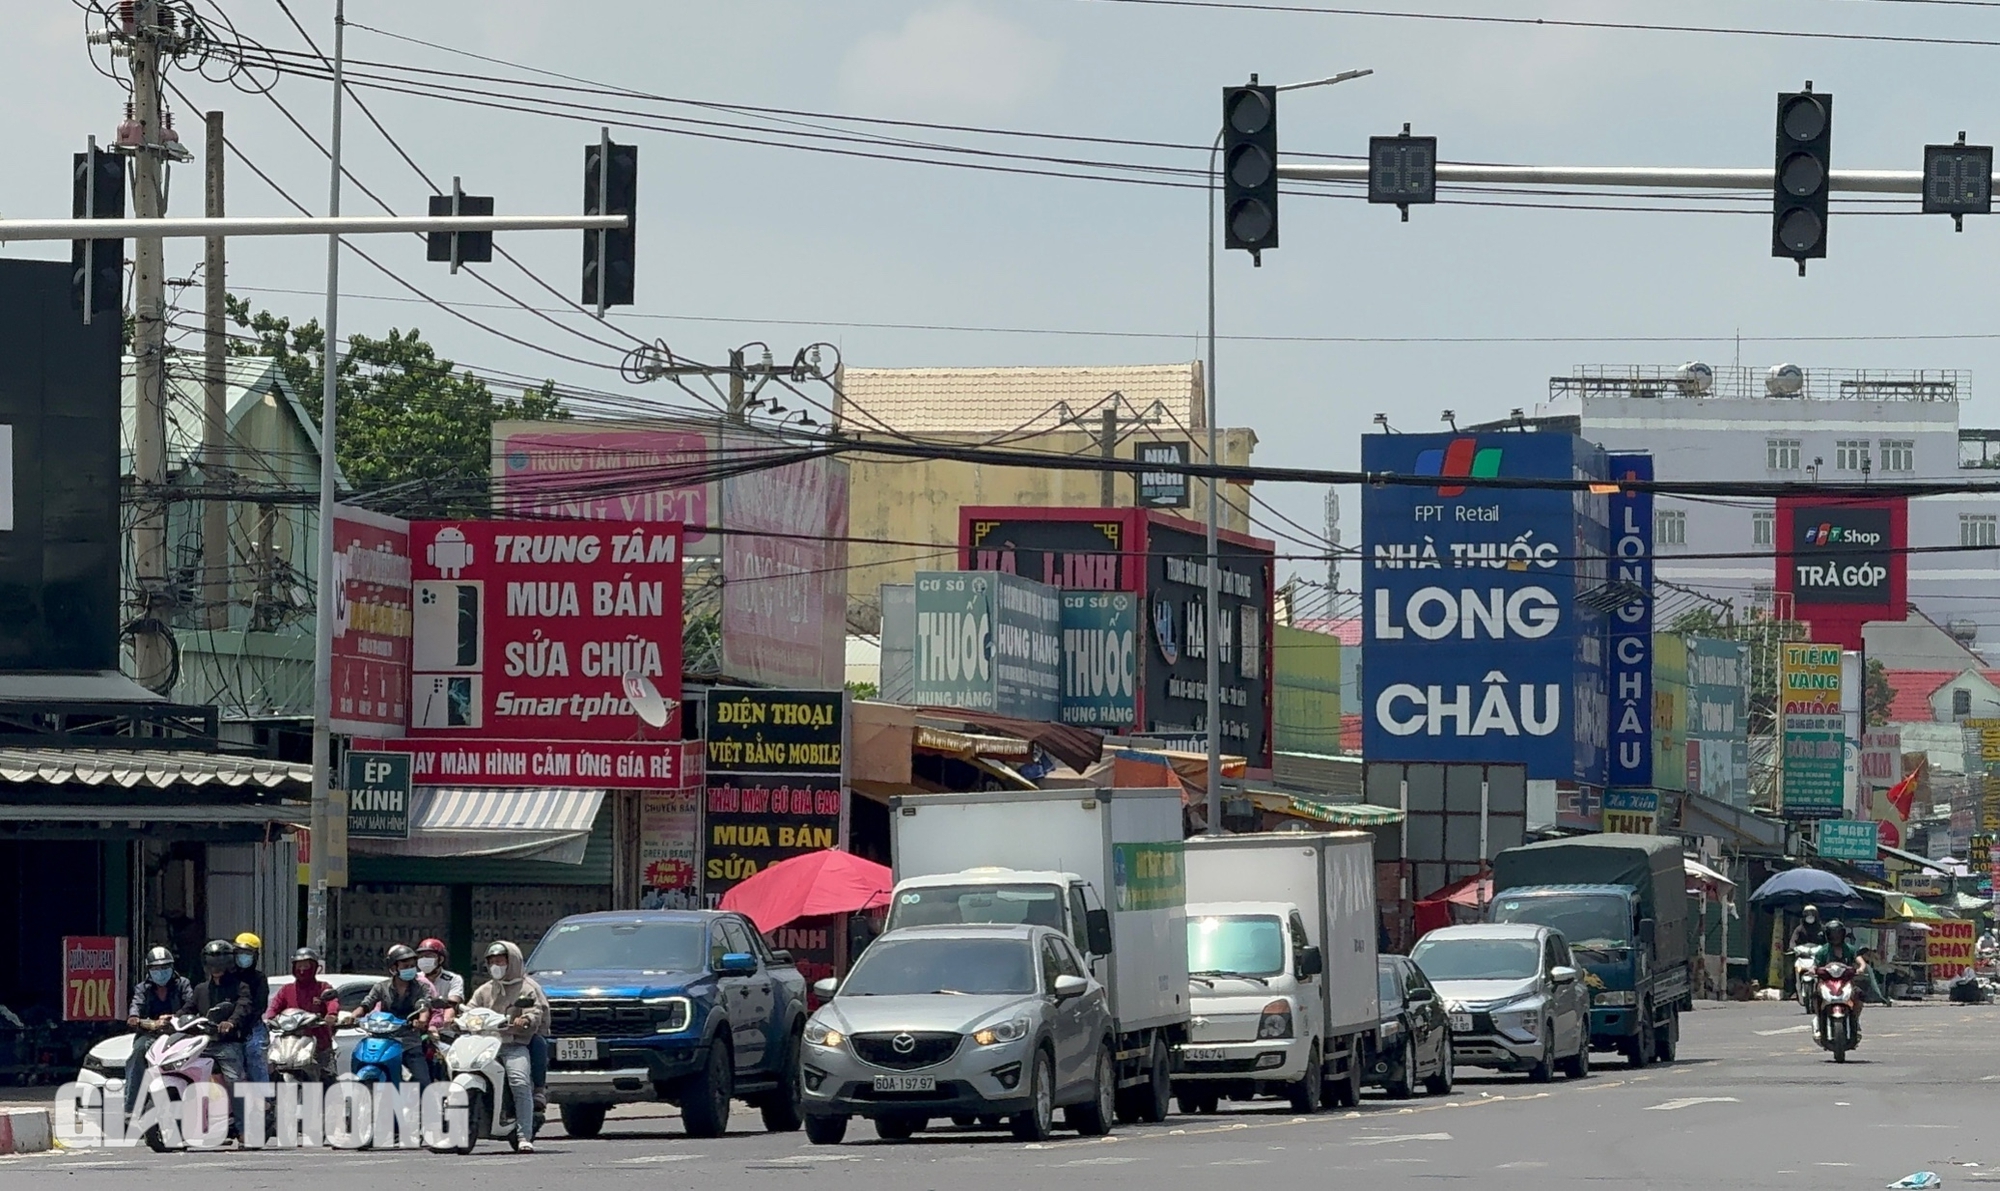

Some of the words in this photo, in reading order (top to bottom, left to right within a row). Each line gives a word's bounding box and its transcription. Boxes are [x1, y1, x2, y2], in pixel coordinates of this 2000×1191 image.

[1144, 445, 1181, 464] NHÀ
[1415, 506, 1445, 522] FPT
[1456, 504, 1500, 522] Retail
[494, 535, 601, 564] TRUNG
[610, 527, 676, 564] TÂM
[1374, 536, 1442, 569] NHÀ
[1449, 530, 1560, 569] THUỐC
[919, 579, 941, 592] CƠ
[945, 577, 966, 592] SỞ
[1797, 562, 1841, 587] TRẢ
[1843, 562, 1887, 587] GÓP
[506, 581, 580, 617] MUA
[592, 573, 663, 616] BÁN
[1064, 596, 1085, 609] CƠ
[1088, 595, 1109, 609] SỞ
[1374, 586, 1561, 641] LONG
[918, 595, 991, 682] THUỐC
[1186, 594, 1206, 660] HÀ
[505, 629, 569, 677] SỬA
[581, 635, 663, 677] CHỮA
[1063, 612, 1133, 698] THUỐC
[1788, 646, 1839, 670] TIỆM
[1787, 671, 1840, 691] VÀNG
[494, 691, 672, 722] Smartpho
[917, 689, 952, 706] HÙNG
[1375, 671, 1561, 737] CHÂU
[1616, 636, 1645, 769] CHÂU
[717, 696, 767, 730] ĐIỆN
[770, 703, 834, 731] THOẠI
[1062, 704, 1097, 723] HÙNG
[708, 735, 743, 769] VIỆT
[744, 731, 786, 765] BẰNG
[788, 743, 841, 766] MOBILE
[1165, 735, 1209, 754] HUỐC
[364, 758, 392, 783] ÉP
[440, 748, 480, 775] MÀN
[485, 748, 528, 776] HÌNH
[532, 746, 571, 777] CẢM
[575, 748, 612, 778] ỨNG
[616, 750, 646, 778] GÍA
[650, 748, 673, 779] RẺ
[1861, 752, 1892, 779] KIM
[351, 786, 404, 812] KÍNH
[741, 783, 770, 814] MÁY
[771, 785, 790, 814] CŨ
[791, 784, 814, 815] GIÁ
[814, 790, 841, 816] CAO
[348, 815, 368, 829] THAY
[368, 813, 386, 830] MÀN
[1824, 825, 1872, 837] D-MART
[713, 825, 772, 848] MUA
[778, 823, 833, 848] BÁN
[706, 852, 759, 880] SỬA
[1928, 922, 1972, 939] CƠM
[1928, 942, 1971, 957] CHAY
[70, 978, 112, 1017] 70K
[567, 1040, 586, 1050] 51D
